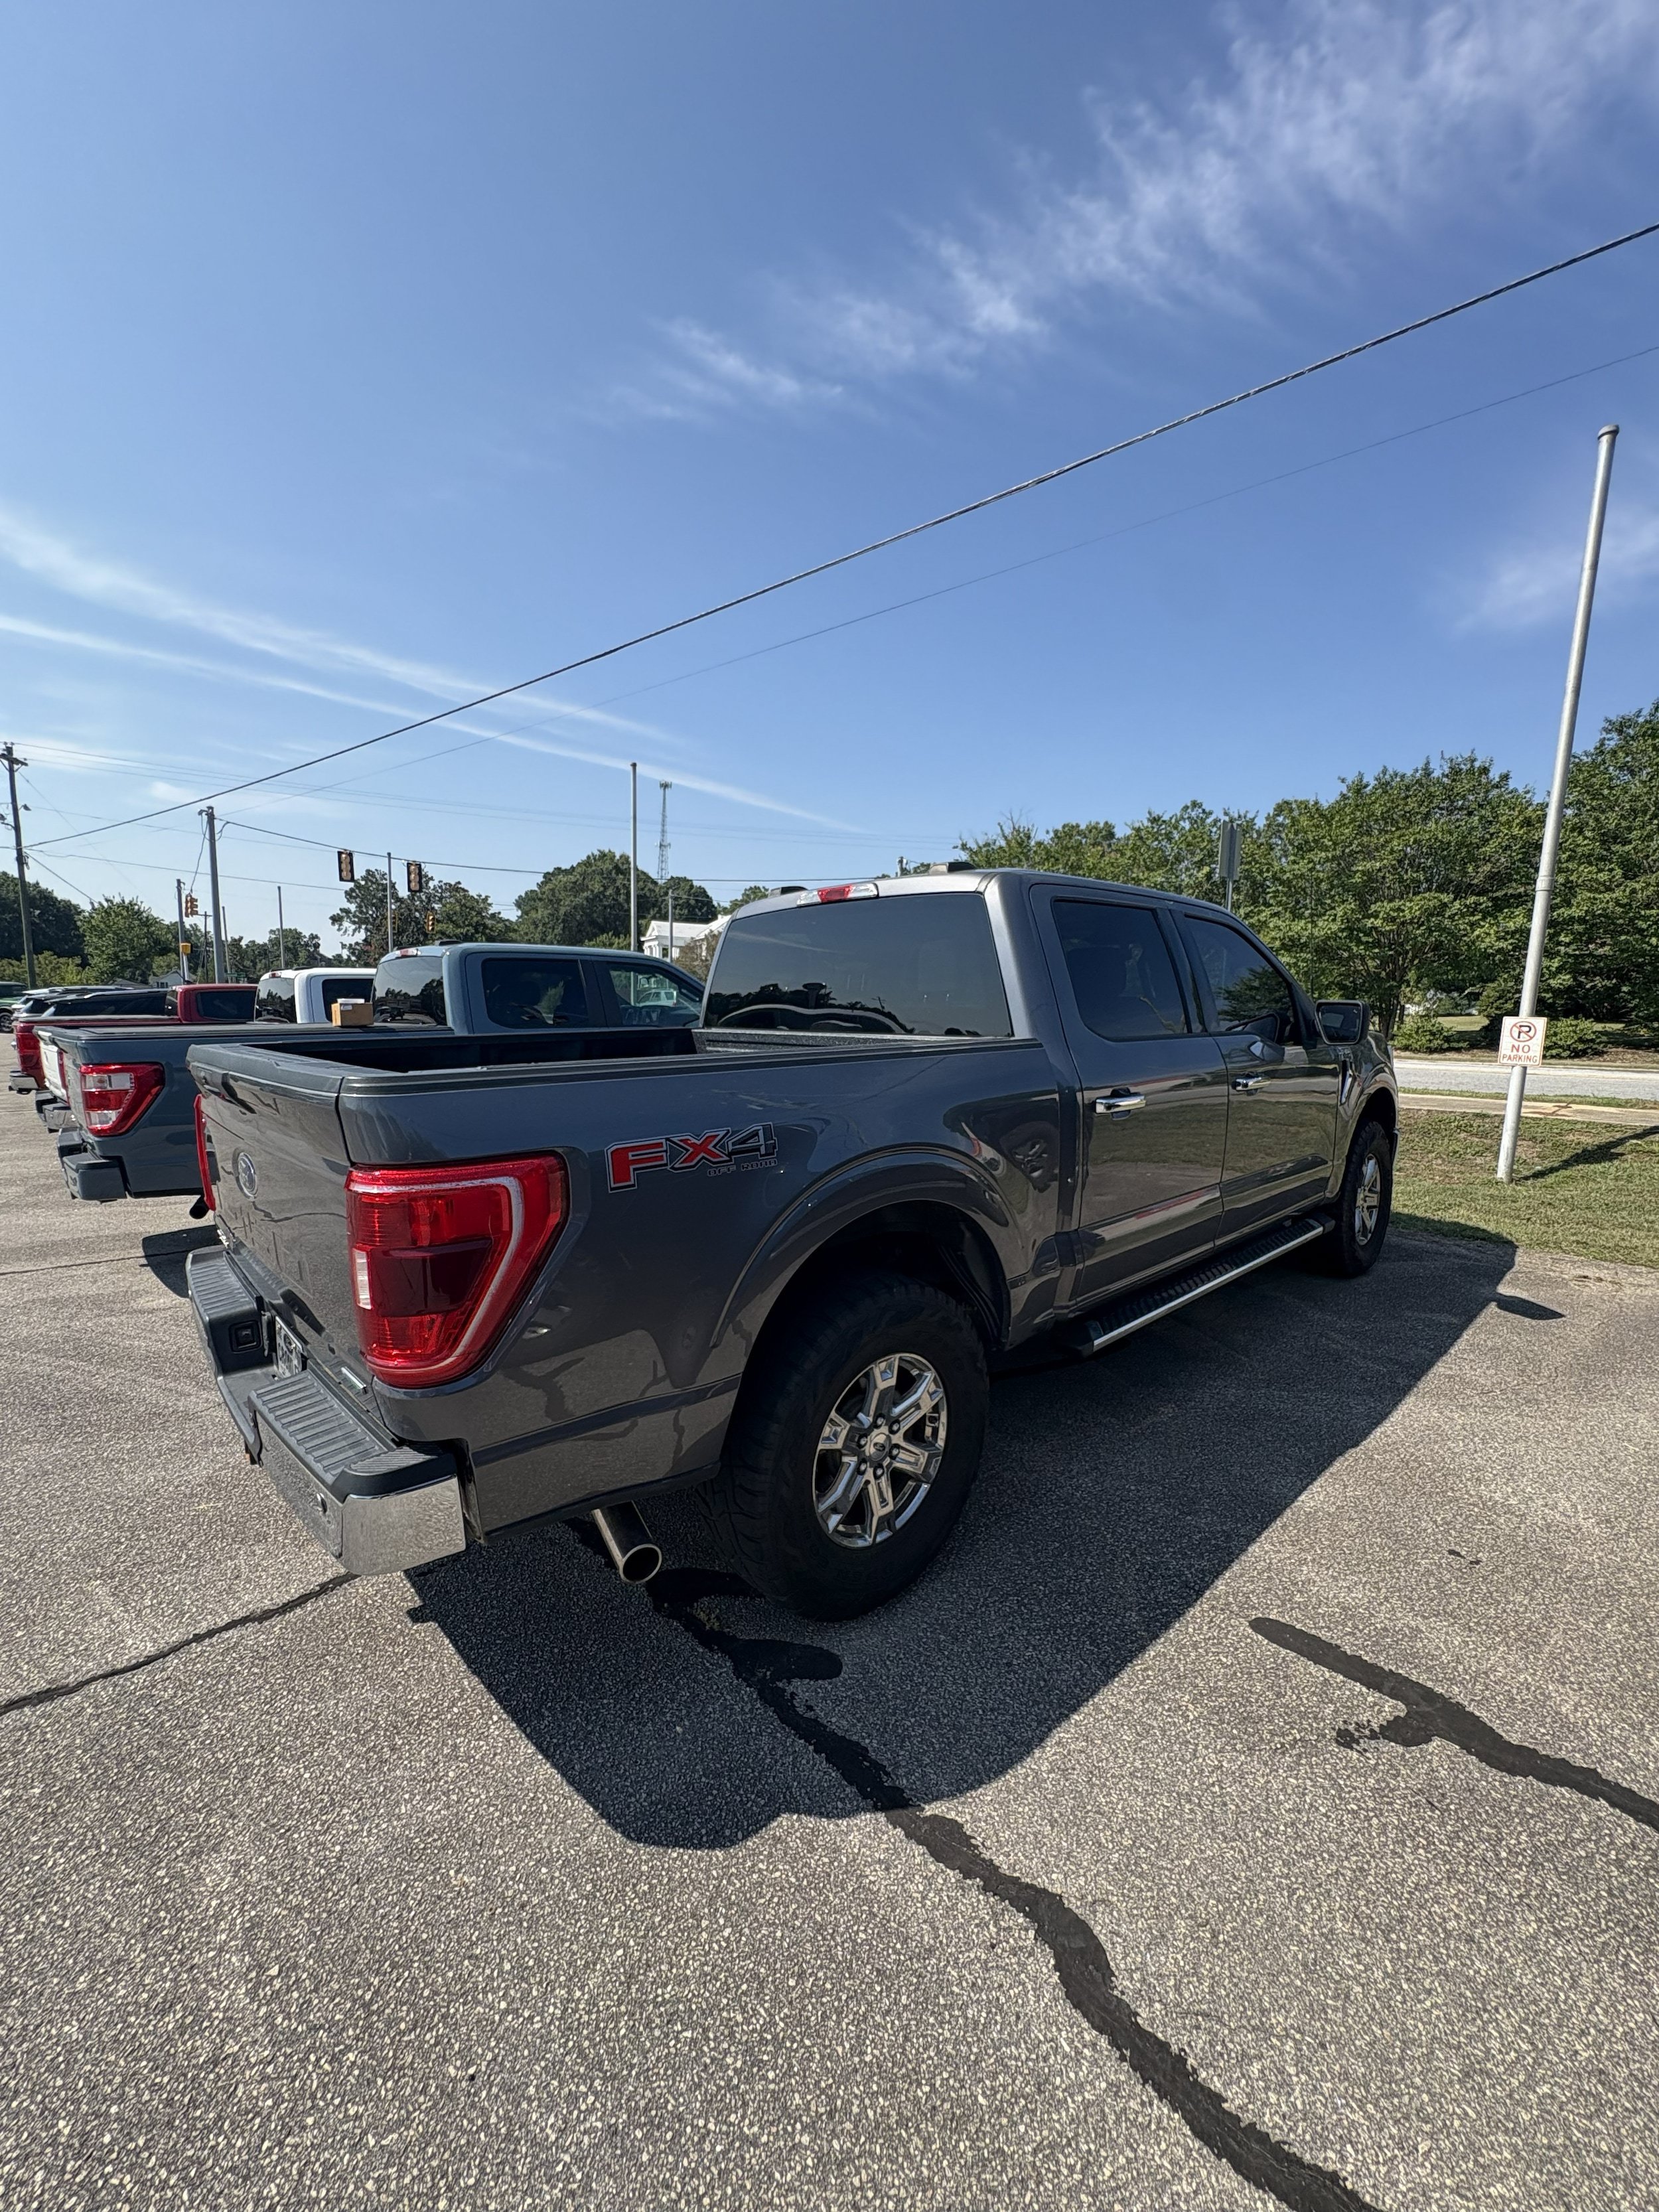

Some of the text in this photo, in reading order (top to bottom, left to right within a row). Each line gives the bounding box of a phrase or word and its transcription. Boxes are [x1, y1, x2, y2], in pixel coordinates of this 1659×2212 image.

[1511, 1044, 1530, 1053] NO
[1502, 1054, 1538, 1063] PARKING
[605, 1122, 778, 1193] FX4
[707, 1158, 778, 1177] OFF ROAD
